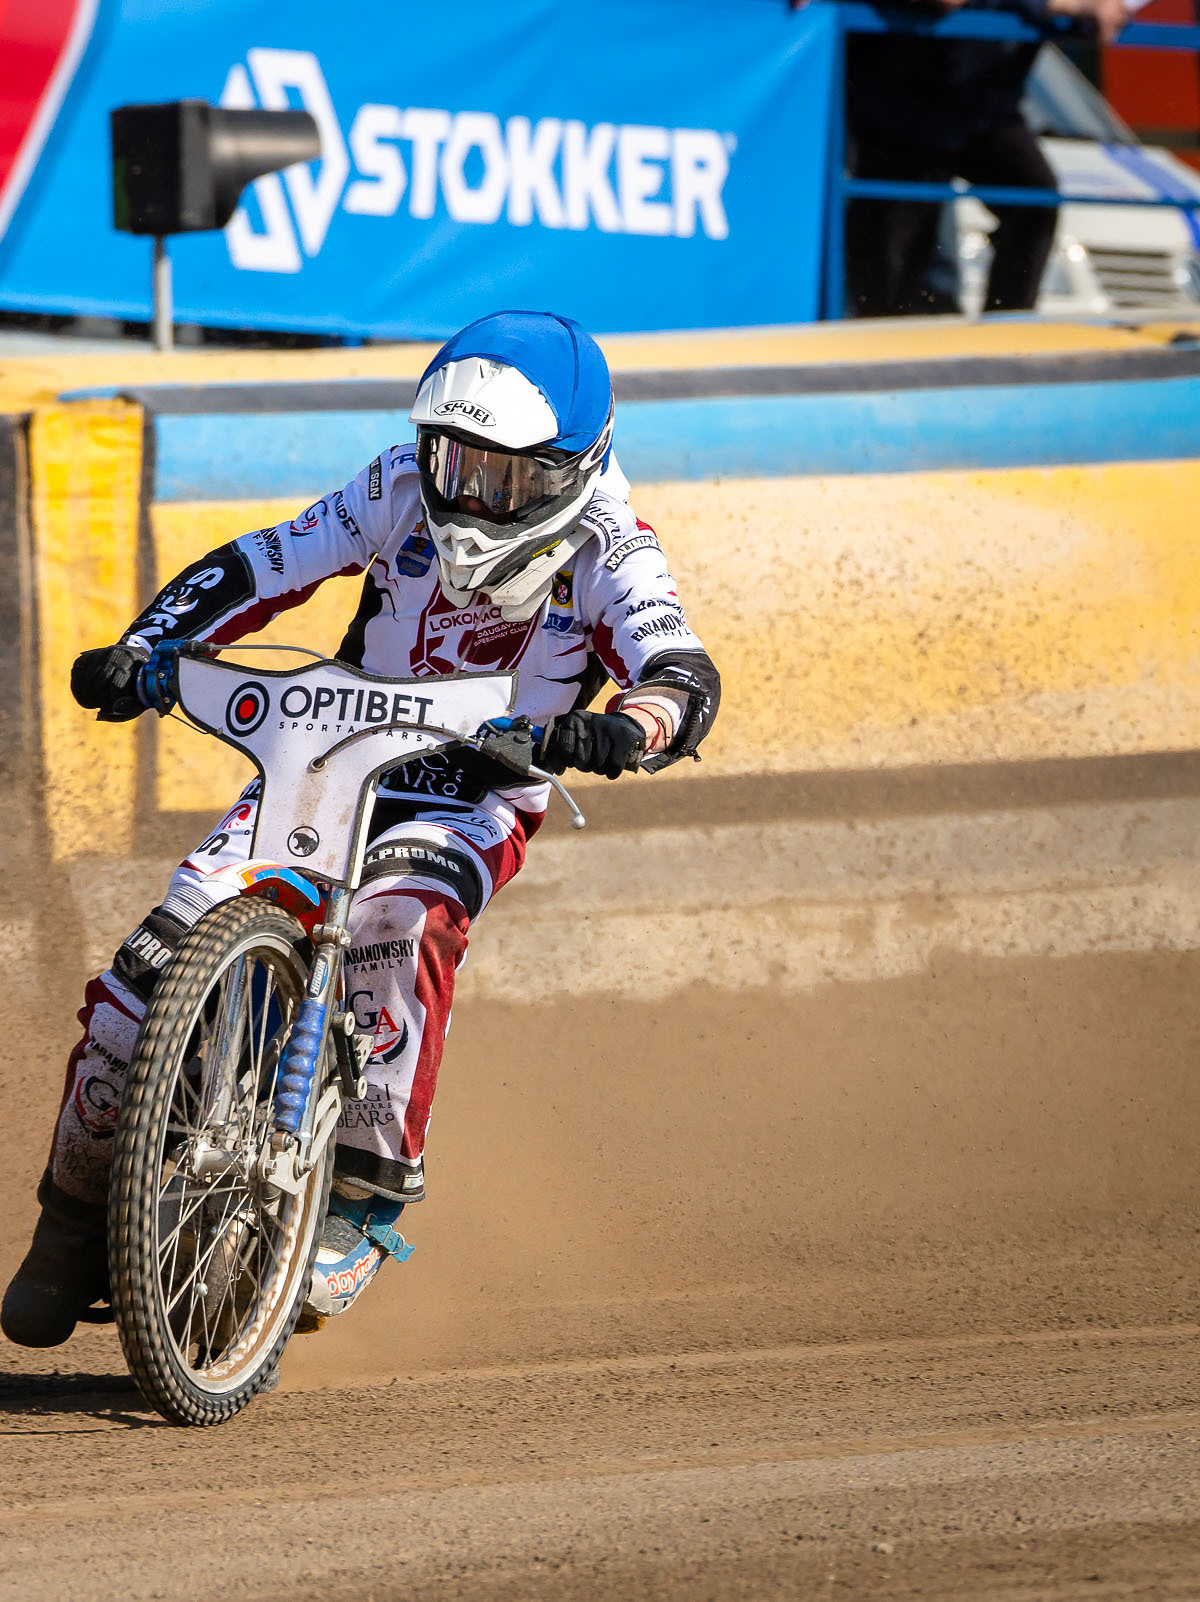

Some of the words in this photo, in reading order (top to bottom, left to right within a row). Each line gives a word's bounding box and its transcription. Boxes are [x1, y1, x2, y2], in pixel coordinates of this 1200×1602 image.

[344, 103, 729, 239] STOKKER
[510, 625, 529, 635] CLUB
[280, 685, 435, 726] OPTIBET
[279, 721, 355, 734] SPORTA
[343, 938, 415, 967] ARANOWSKY
[353, 958, 404, 974] FAMILY
